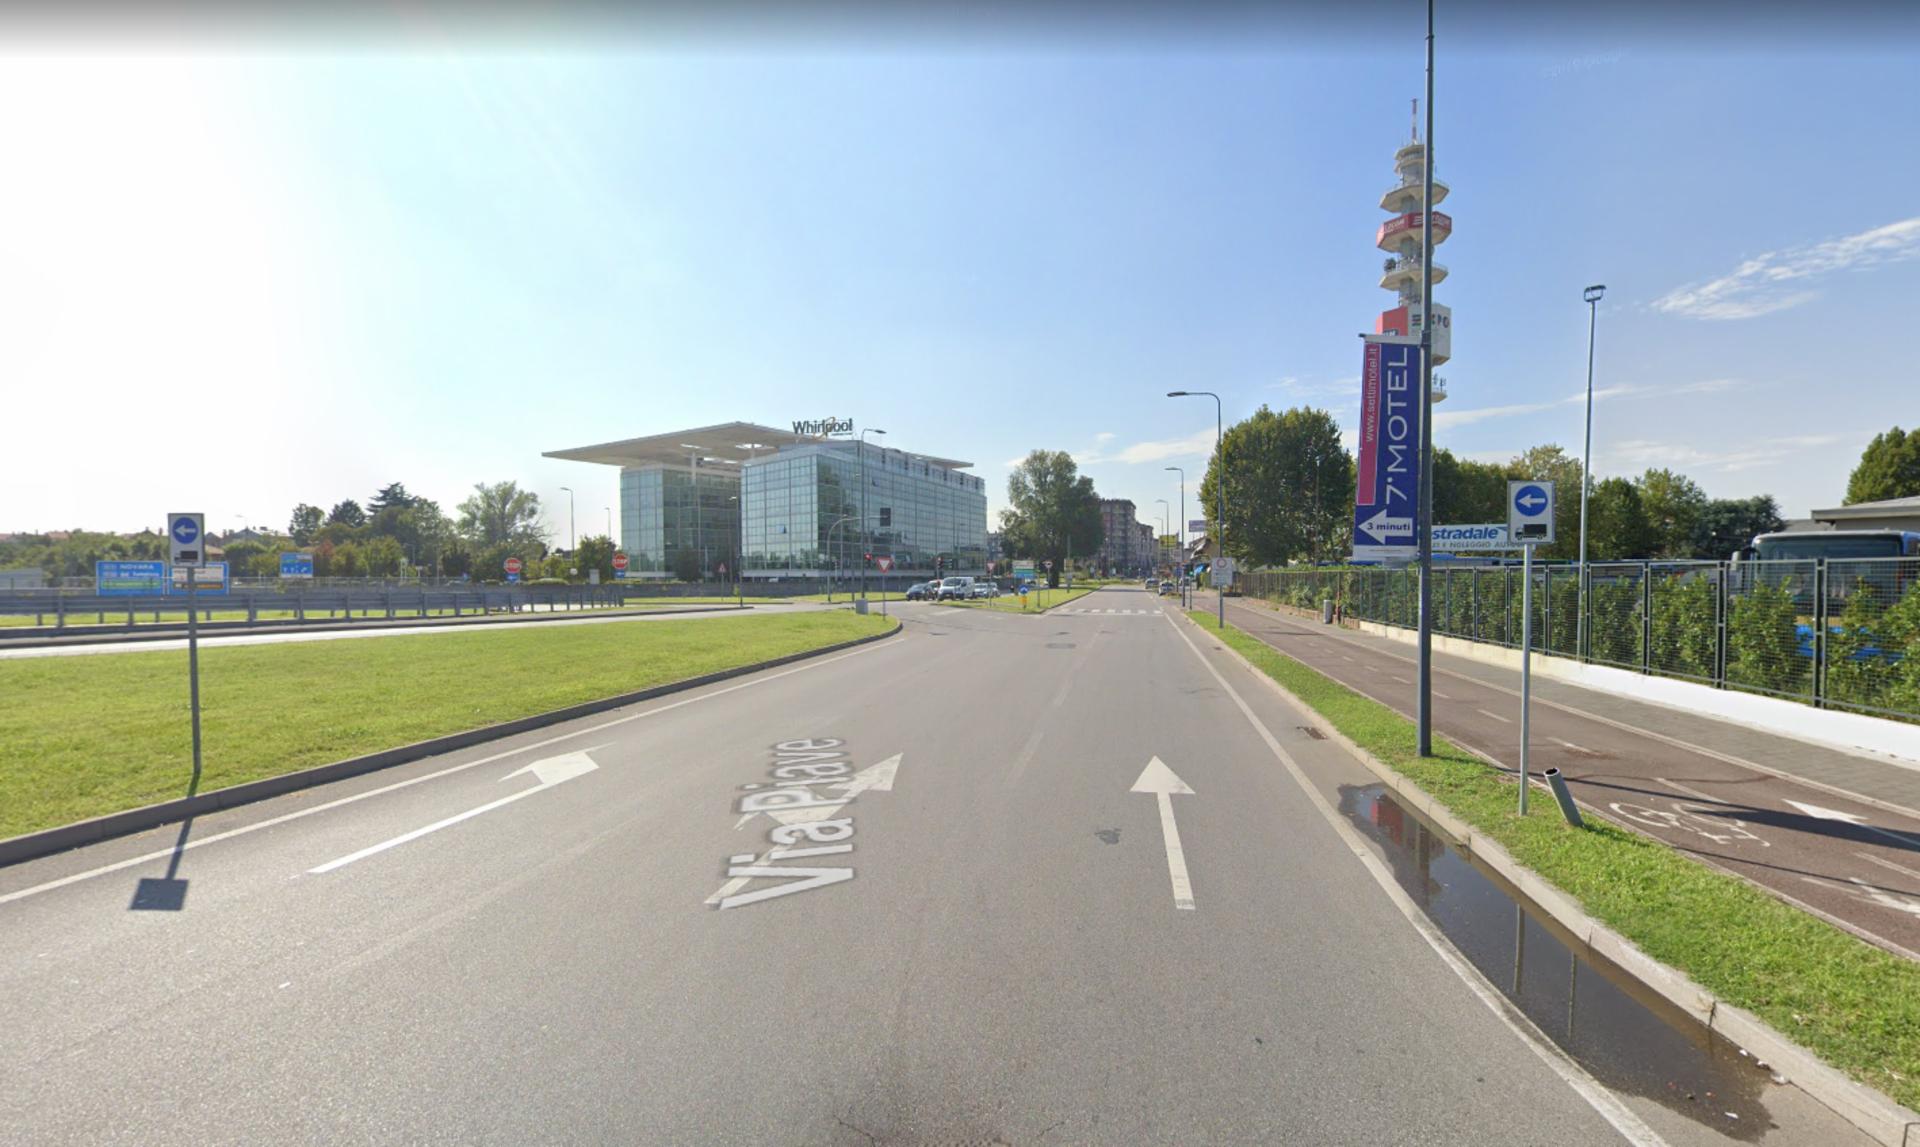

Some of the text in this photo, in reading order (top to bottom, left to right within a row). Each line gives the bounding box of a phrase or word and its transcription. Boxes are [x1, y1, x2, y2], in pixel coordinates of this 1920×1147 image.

[792, 418, 853, 436] Whirlpool
[1367, 522, 1411, 531] 3 minuti
[1431, 527, 1499, 540] stradale
